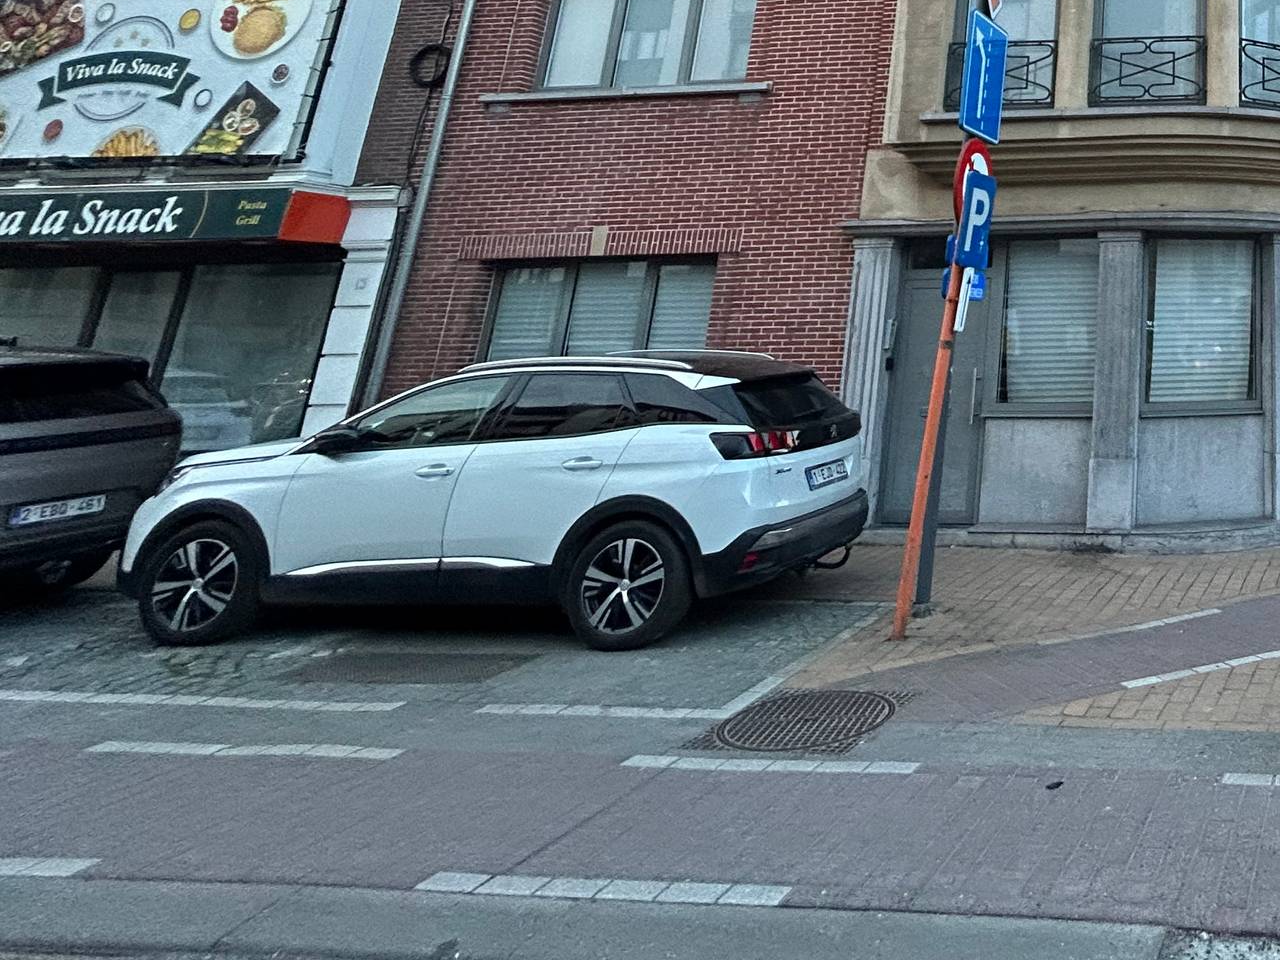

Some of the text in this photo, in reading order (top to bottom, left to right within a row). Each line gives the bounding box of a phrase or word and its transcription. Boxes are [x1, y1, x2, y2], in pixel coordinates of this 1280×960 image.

[66, 58, 179, 82] Viva la Snack
[29, 199, 69, 236] la
[73, 195, 184, 236] Snack
[238, 200, 268, 210] Pasta
[235, 215, 261, 226] Grill
[963, 187, 991, 252] P
